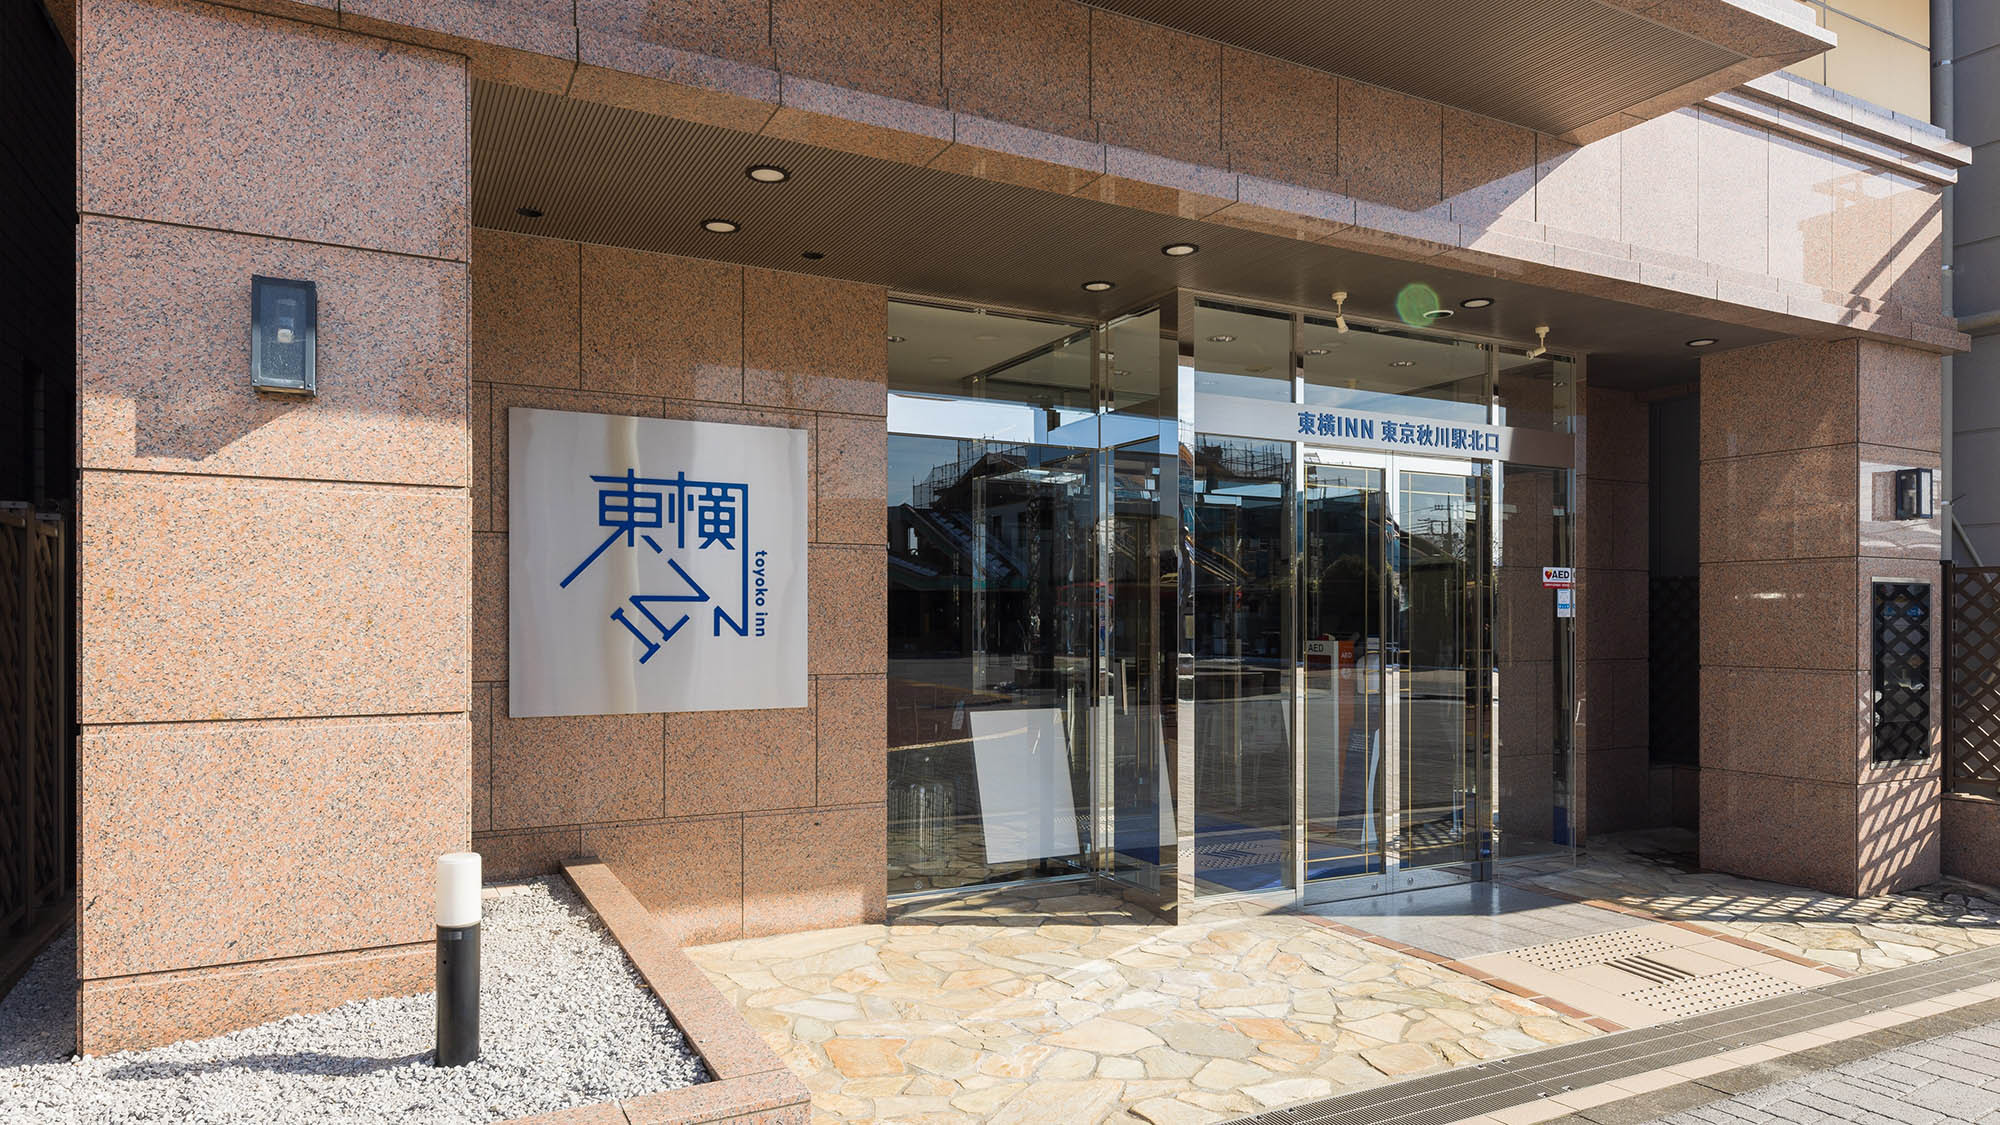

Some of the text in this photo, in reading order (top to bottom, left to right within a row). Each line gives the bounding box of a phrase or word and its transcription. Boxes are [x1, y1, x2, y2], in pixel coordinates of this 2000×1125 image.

[1297, 411, 1499, 453] 東横INN 東京秋川駅北口
[1552, 570, 1570, 579] AED
[752, 550, 768, 637] toyoko inn
[1308, 643, 1324, 652] AED
